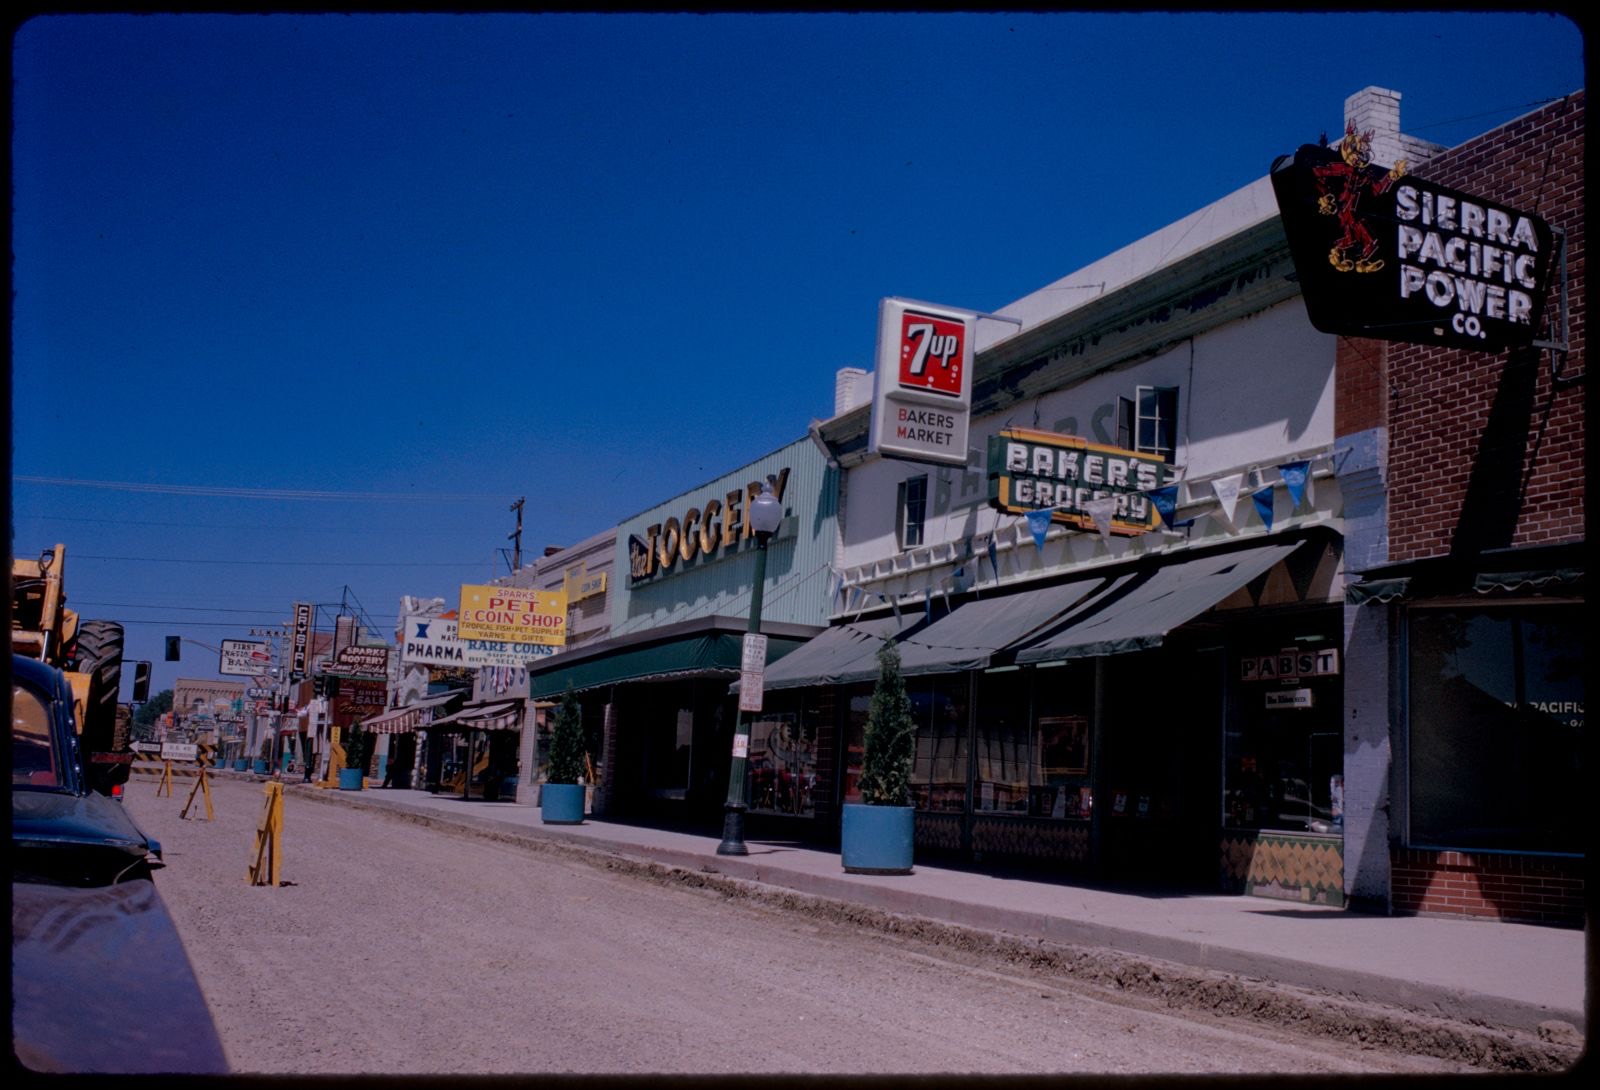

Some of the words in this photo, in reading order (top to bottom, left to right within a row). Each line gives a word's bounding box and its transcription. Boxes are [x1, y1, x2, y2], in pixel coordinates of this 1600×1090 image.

[1395, 184, 1539, 253] SIERRA
[1397, 224, 1538, 290] PACIFIC
[1400, 264, 1533, 326] POWER
[1452, 312, 1487, 340] CO.
[898, 408, 954, 430] BAKERS
[896, 427, 954, 447] MARKET
[1006, 442, 1158, 490] BAKER'S
[497, 589, 536, 599] SPARKS
[489, 597, 540, 612] PET
[475, 610, 514, 625] COIN
[521, 614, 564, 628] SHOP
[461, 622, 496, 631] TROPICAL
[514, 626, 528, 634] PET
[531, 627, 565, 636] SUPPLIES
[478, 631, 505, 639] YARNS
[521, 634, 545, 642] GIFTS
[294, 605, 310, 672] CRYSTAL
[346, 646, 386, 657] SPARKS
[407, 643, 464, 661] PHARMA
[468, 640, 507, 653] RARE
[513, 642, 554, 656] COINS
[486, 652, 537, 660] SUPPLIES
[340, 654, 385, 664] BOOTERY
[1241, 653, 1334, 677] PABST
[355, 695, 386, 705] SALE
